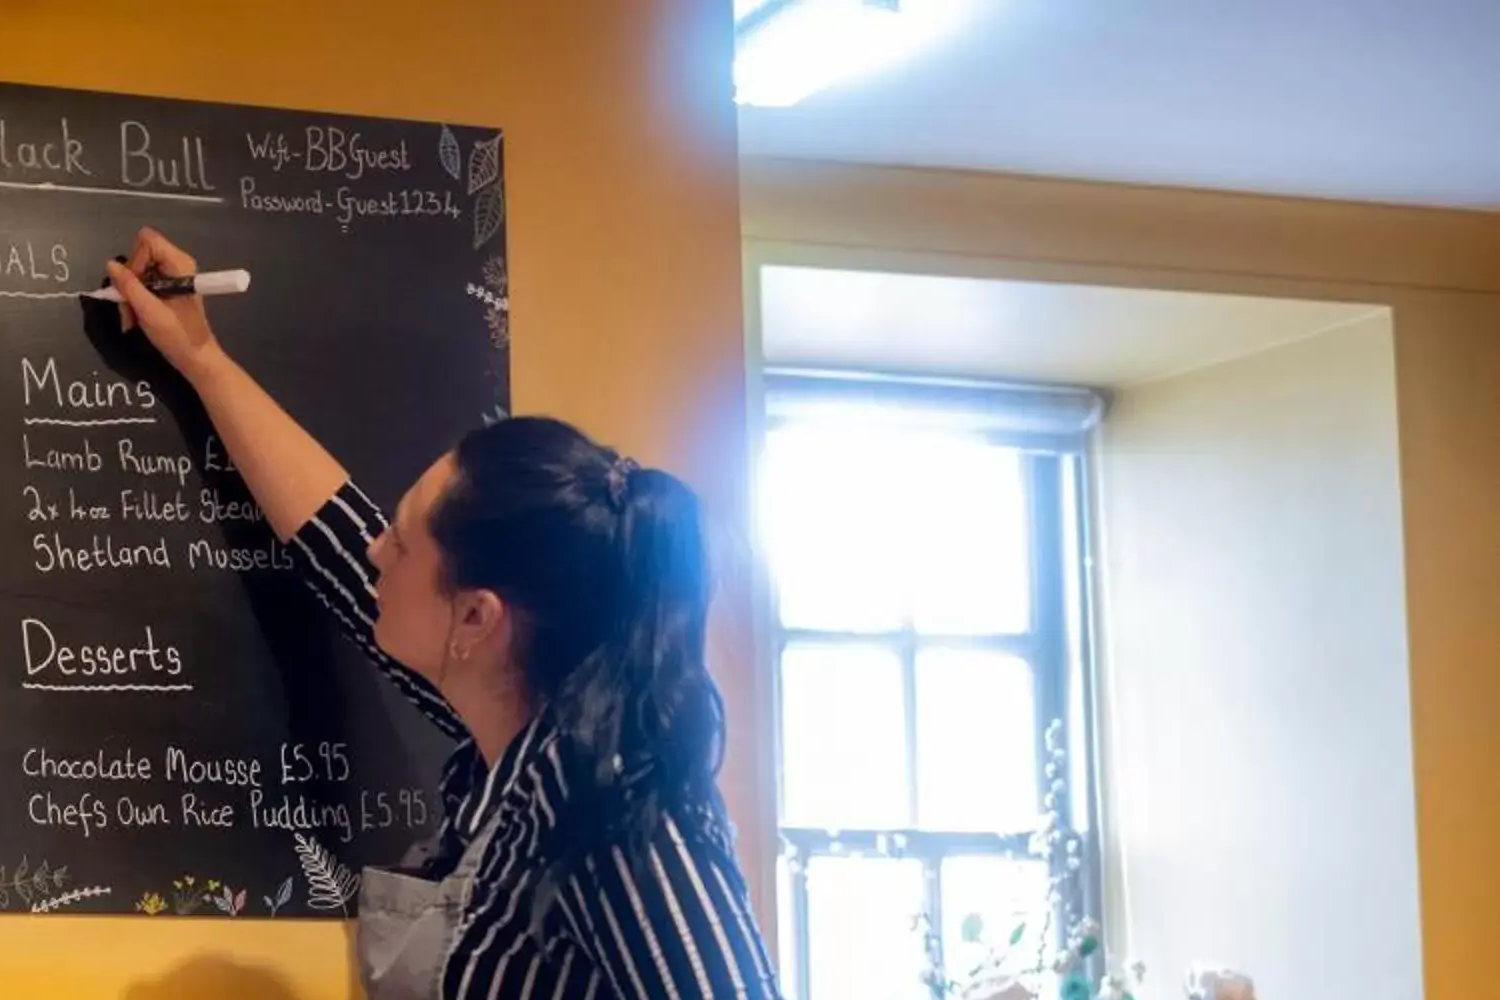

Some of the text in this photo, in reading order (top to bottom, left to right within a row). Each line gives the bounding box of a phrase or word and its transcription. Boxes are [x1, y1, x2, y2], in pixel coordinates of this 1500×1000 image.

[120, 120, 216, 191] Bull
[21, 356, 156, 409] Mains
[22, 433, 102, 472] Lamb
[117, 438, 192, 486] Rump
[120, 489, 191, 521] Fillet
[199, 487, 265, 524] Stea
[32, 531, 294, 573] Shetland Mussels
[21, 618, 182, 675] Desserts
[22, 741, 350, 787] Chocolate Mousse £5.95
[28, 788, 430, 842] Chefs Own Rice Pudding £5.95
